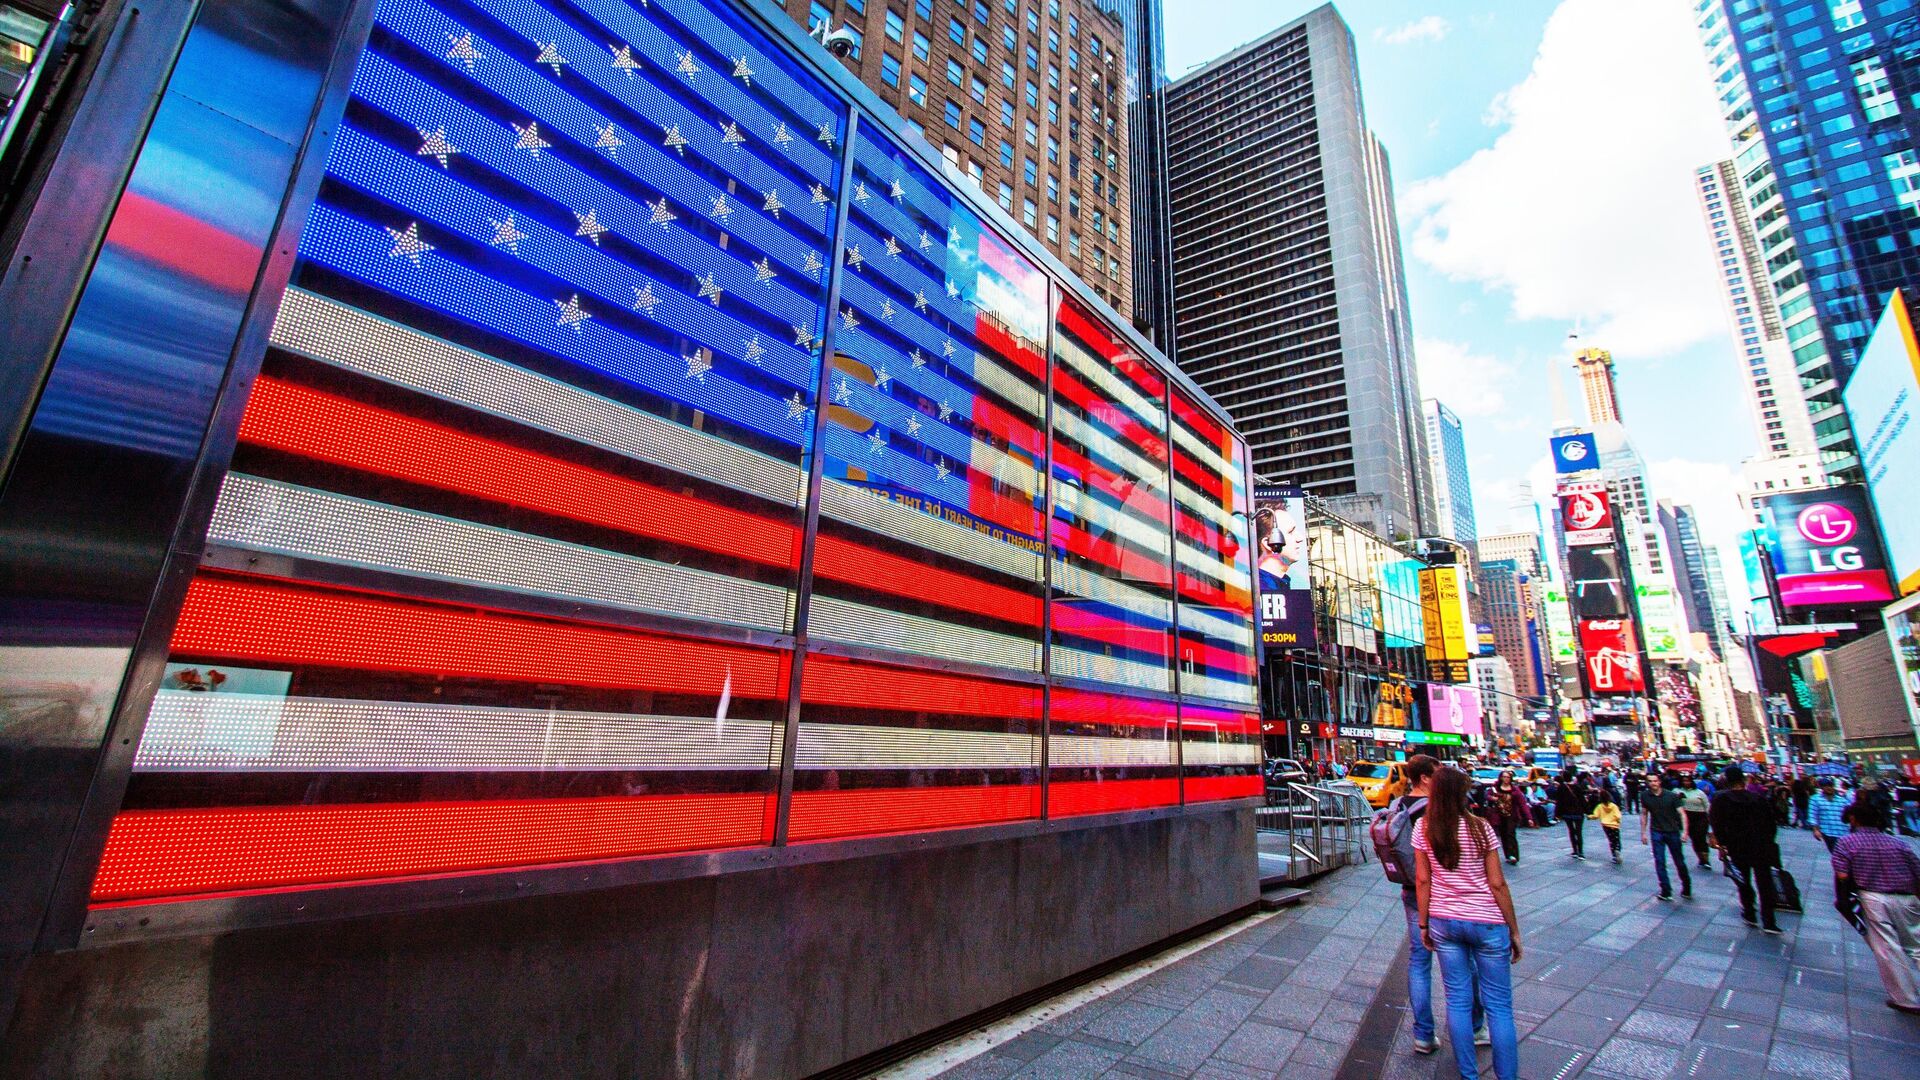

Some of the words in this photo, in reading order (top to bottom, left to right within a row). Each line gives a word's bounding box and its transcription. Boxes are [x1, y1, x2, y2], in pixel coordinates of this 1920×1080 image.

[1808, 545, 1864, 573] LG
[1260, 593, 1287, 620] ER
[1263, 633, 1297, 643] 0:30PM
[1340, 726, 1374, 738] SKECHERS
